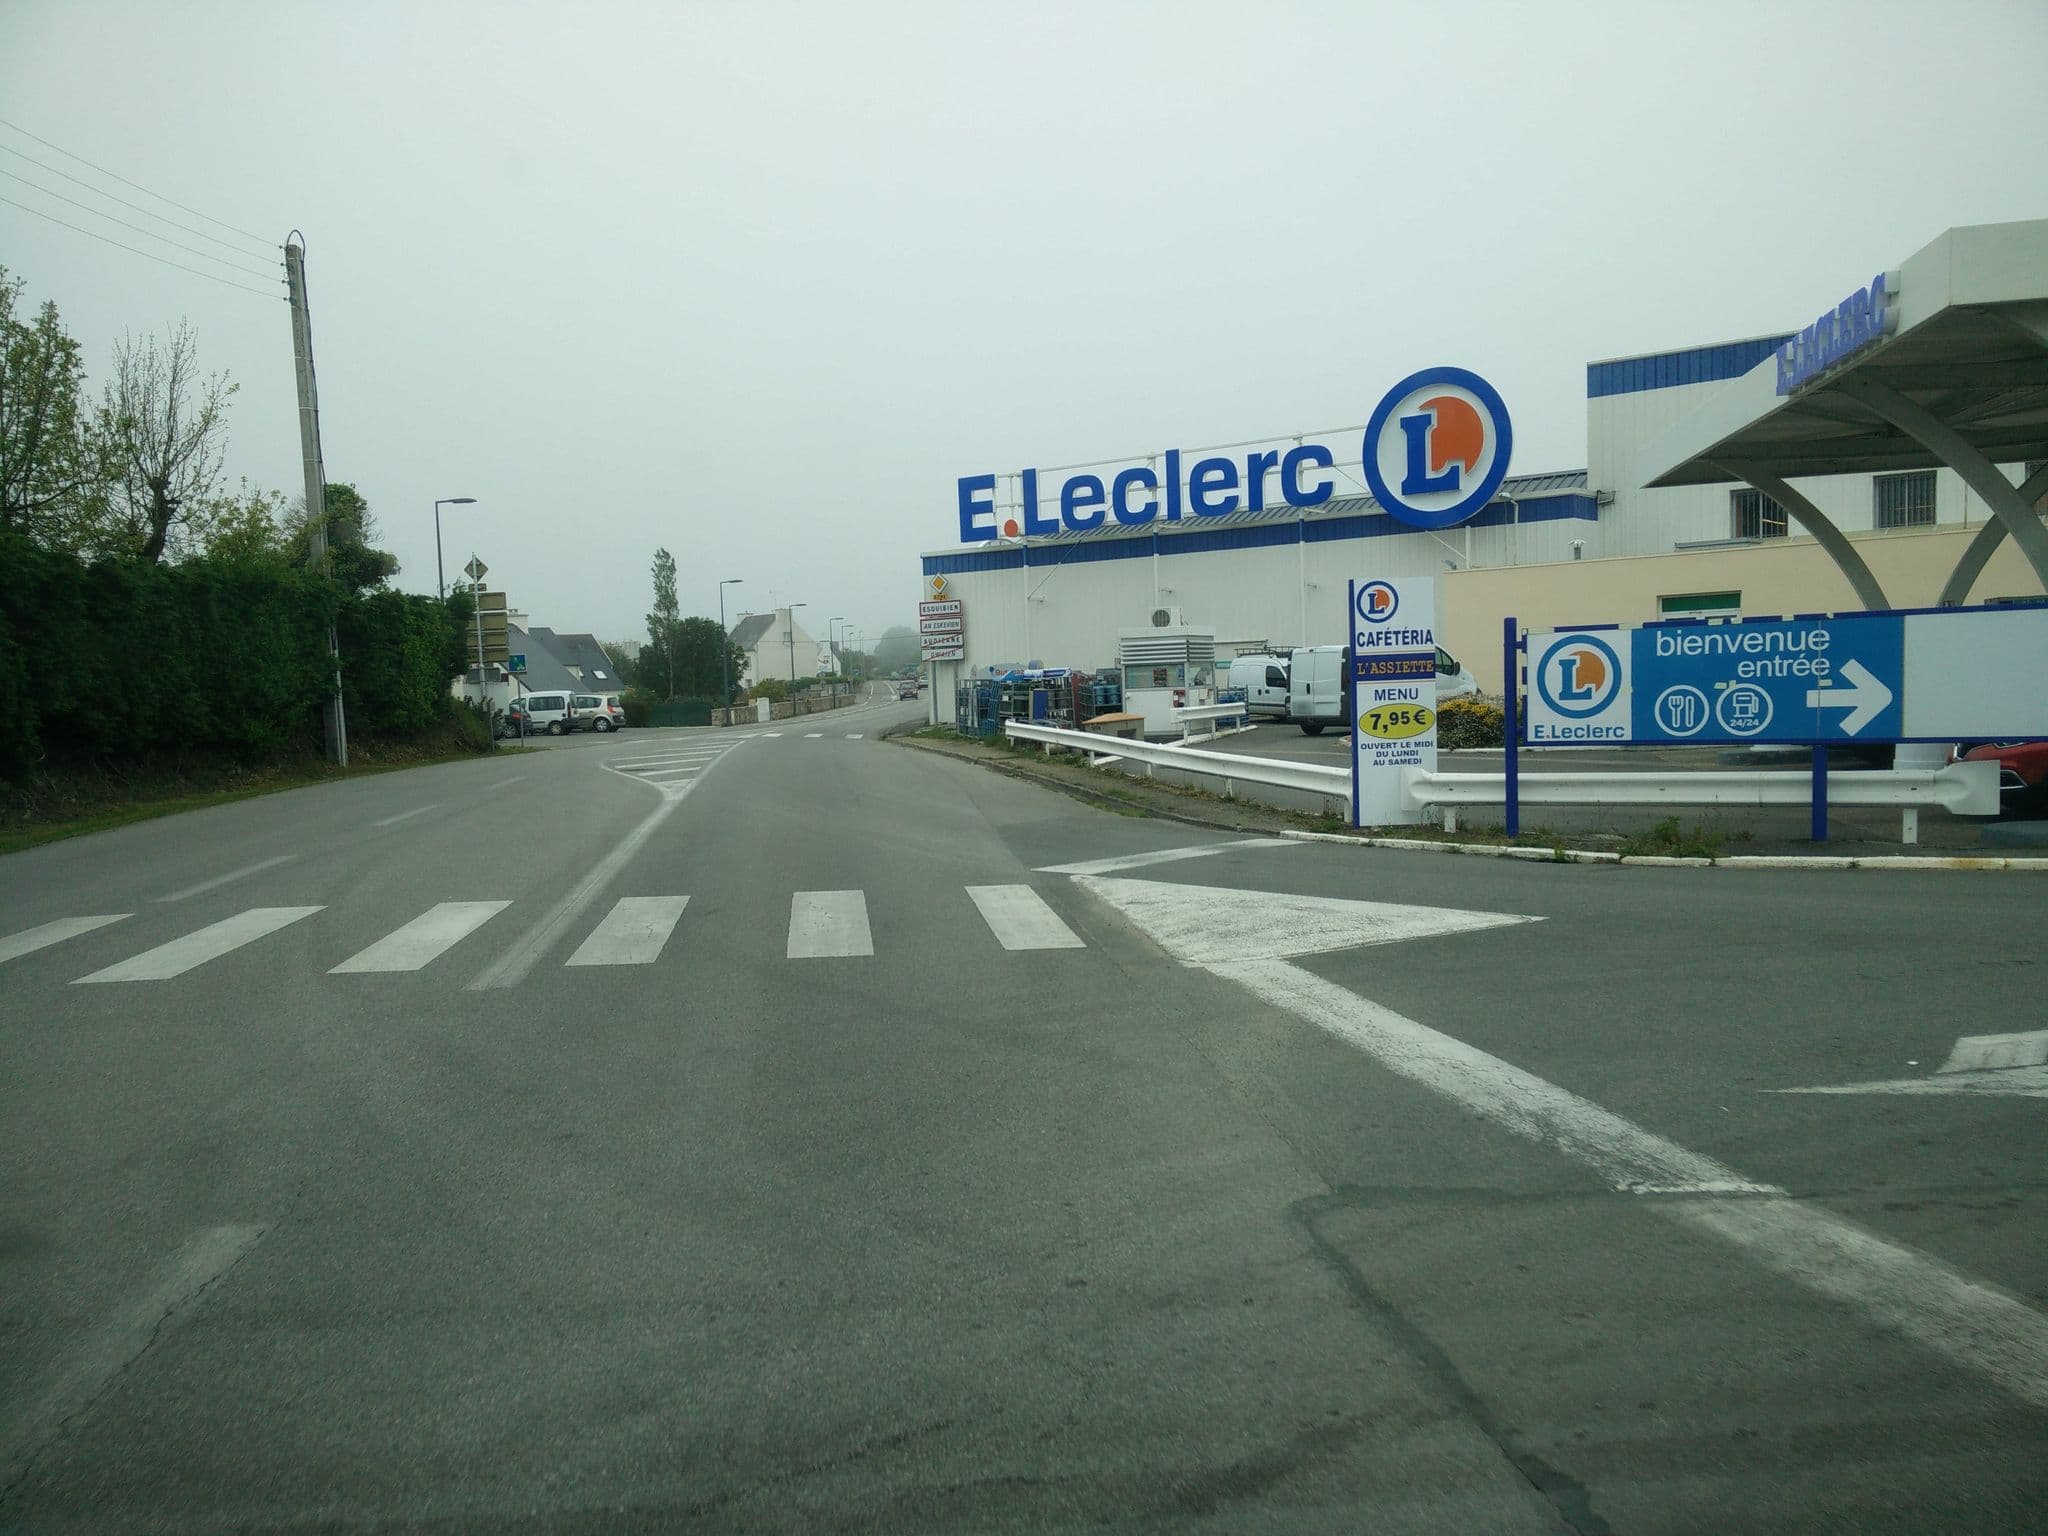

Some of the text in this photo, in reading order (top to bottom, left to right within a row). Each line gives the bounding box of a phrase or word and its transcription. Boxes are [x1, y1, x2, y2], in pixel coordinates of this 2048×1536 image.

[957, 445, 1334, 543] E.Leclerc
[923, 604, 958, 613] ESQUIBIEN
[1356, 626, 1434, 648] CAFÉTÉRIA
[1656, 629, 1831, 656] bienvenue
[1357, 660, 1434, 676] L'ASSIETTE
[1737, 653, 1831, 679] entrée
[1374, 688, 1419, 701] MENU
[1370, 709, 1427, 734] 7,95€
[1730, 719, 1759, 728] 24/24
[1534, 724, 1625, 740] E.Leclerc
[1360, 740, 1434, 750] OUVERT LE MIDI
[1372, 758, 1422, 767] AU SAMEDI
